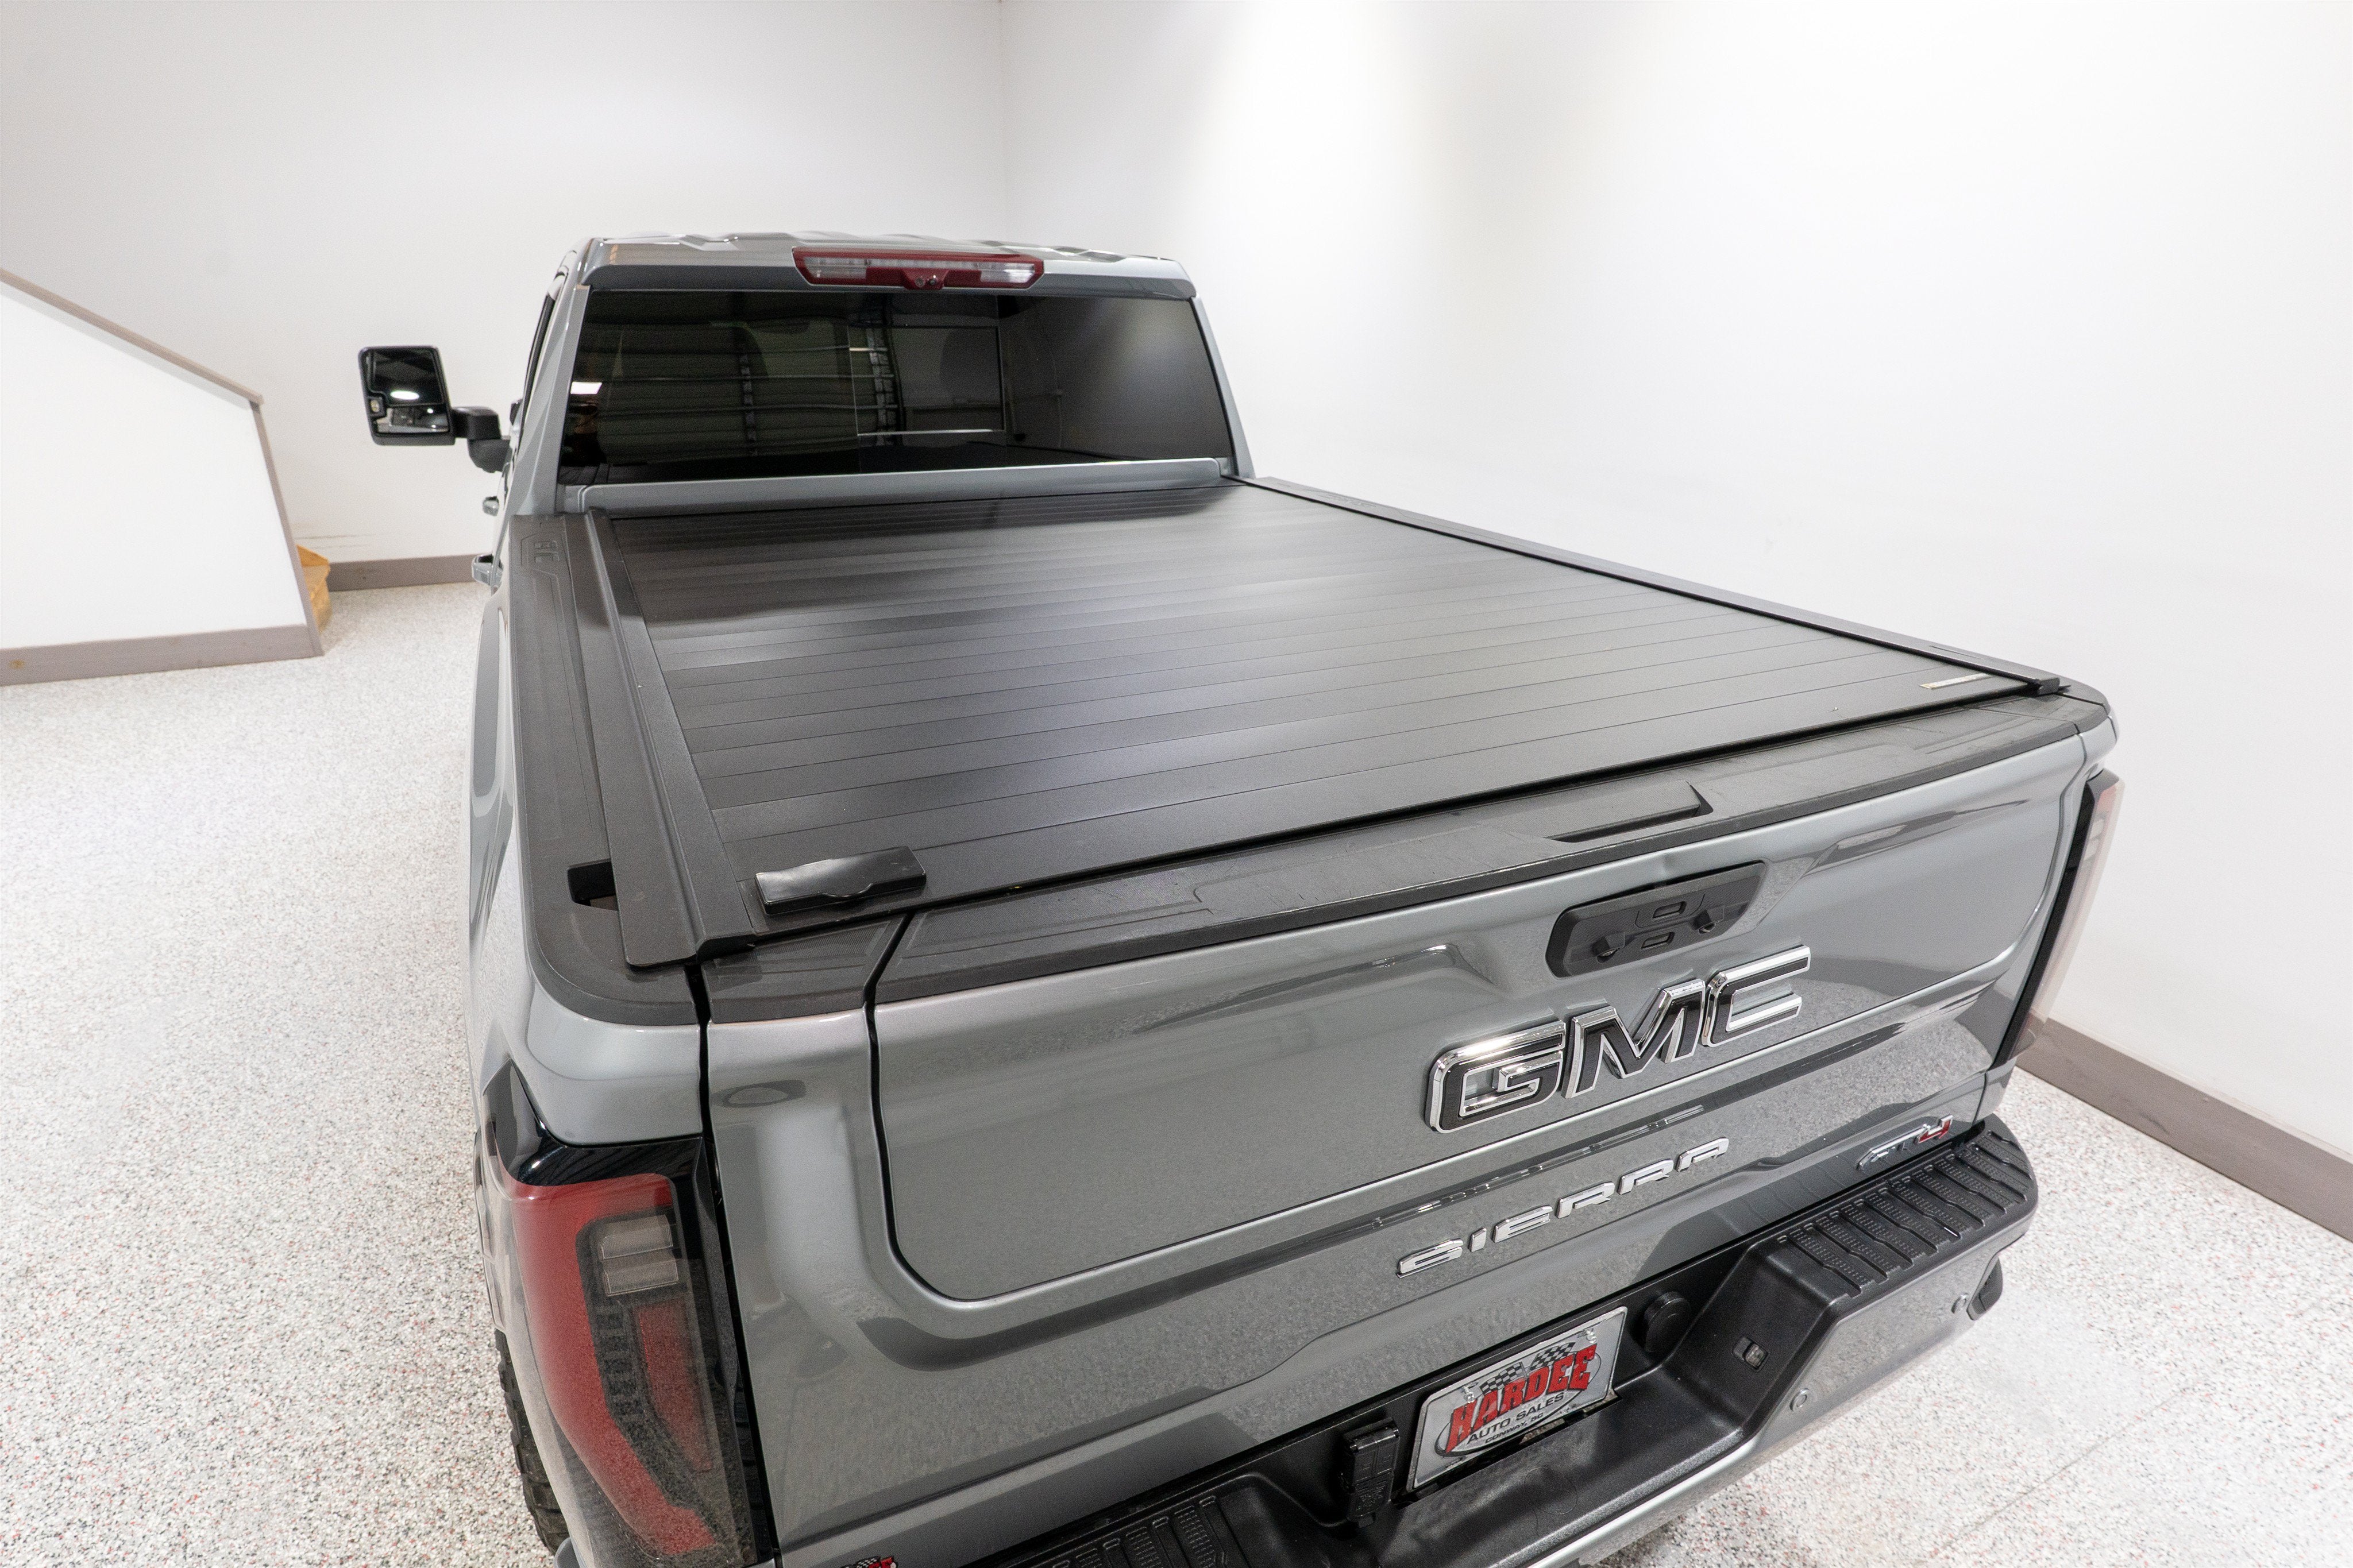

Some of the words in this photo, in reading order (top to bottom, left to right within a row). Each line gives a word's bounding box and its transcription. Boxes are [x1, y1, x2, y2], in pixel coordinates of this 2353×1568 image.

[1426, 945, 1811, 1133] GMC
[1397, 1138, 1729, 1278] SIERRA
[1445, 1344, 1597, 1454] HARDEE
[1467, 1415, 1511, 1445] AUTO
[1516, 1392, 1564, 1421] SALES
[1485, 1422, 1527, 1443] CONWAY,
[1530, 1412, 1544, 1422] SC
